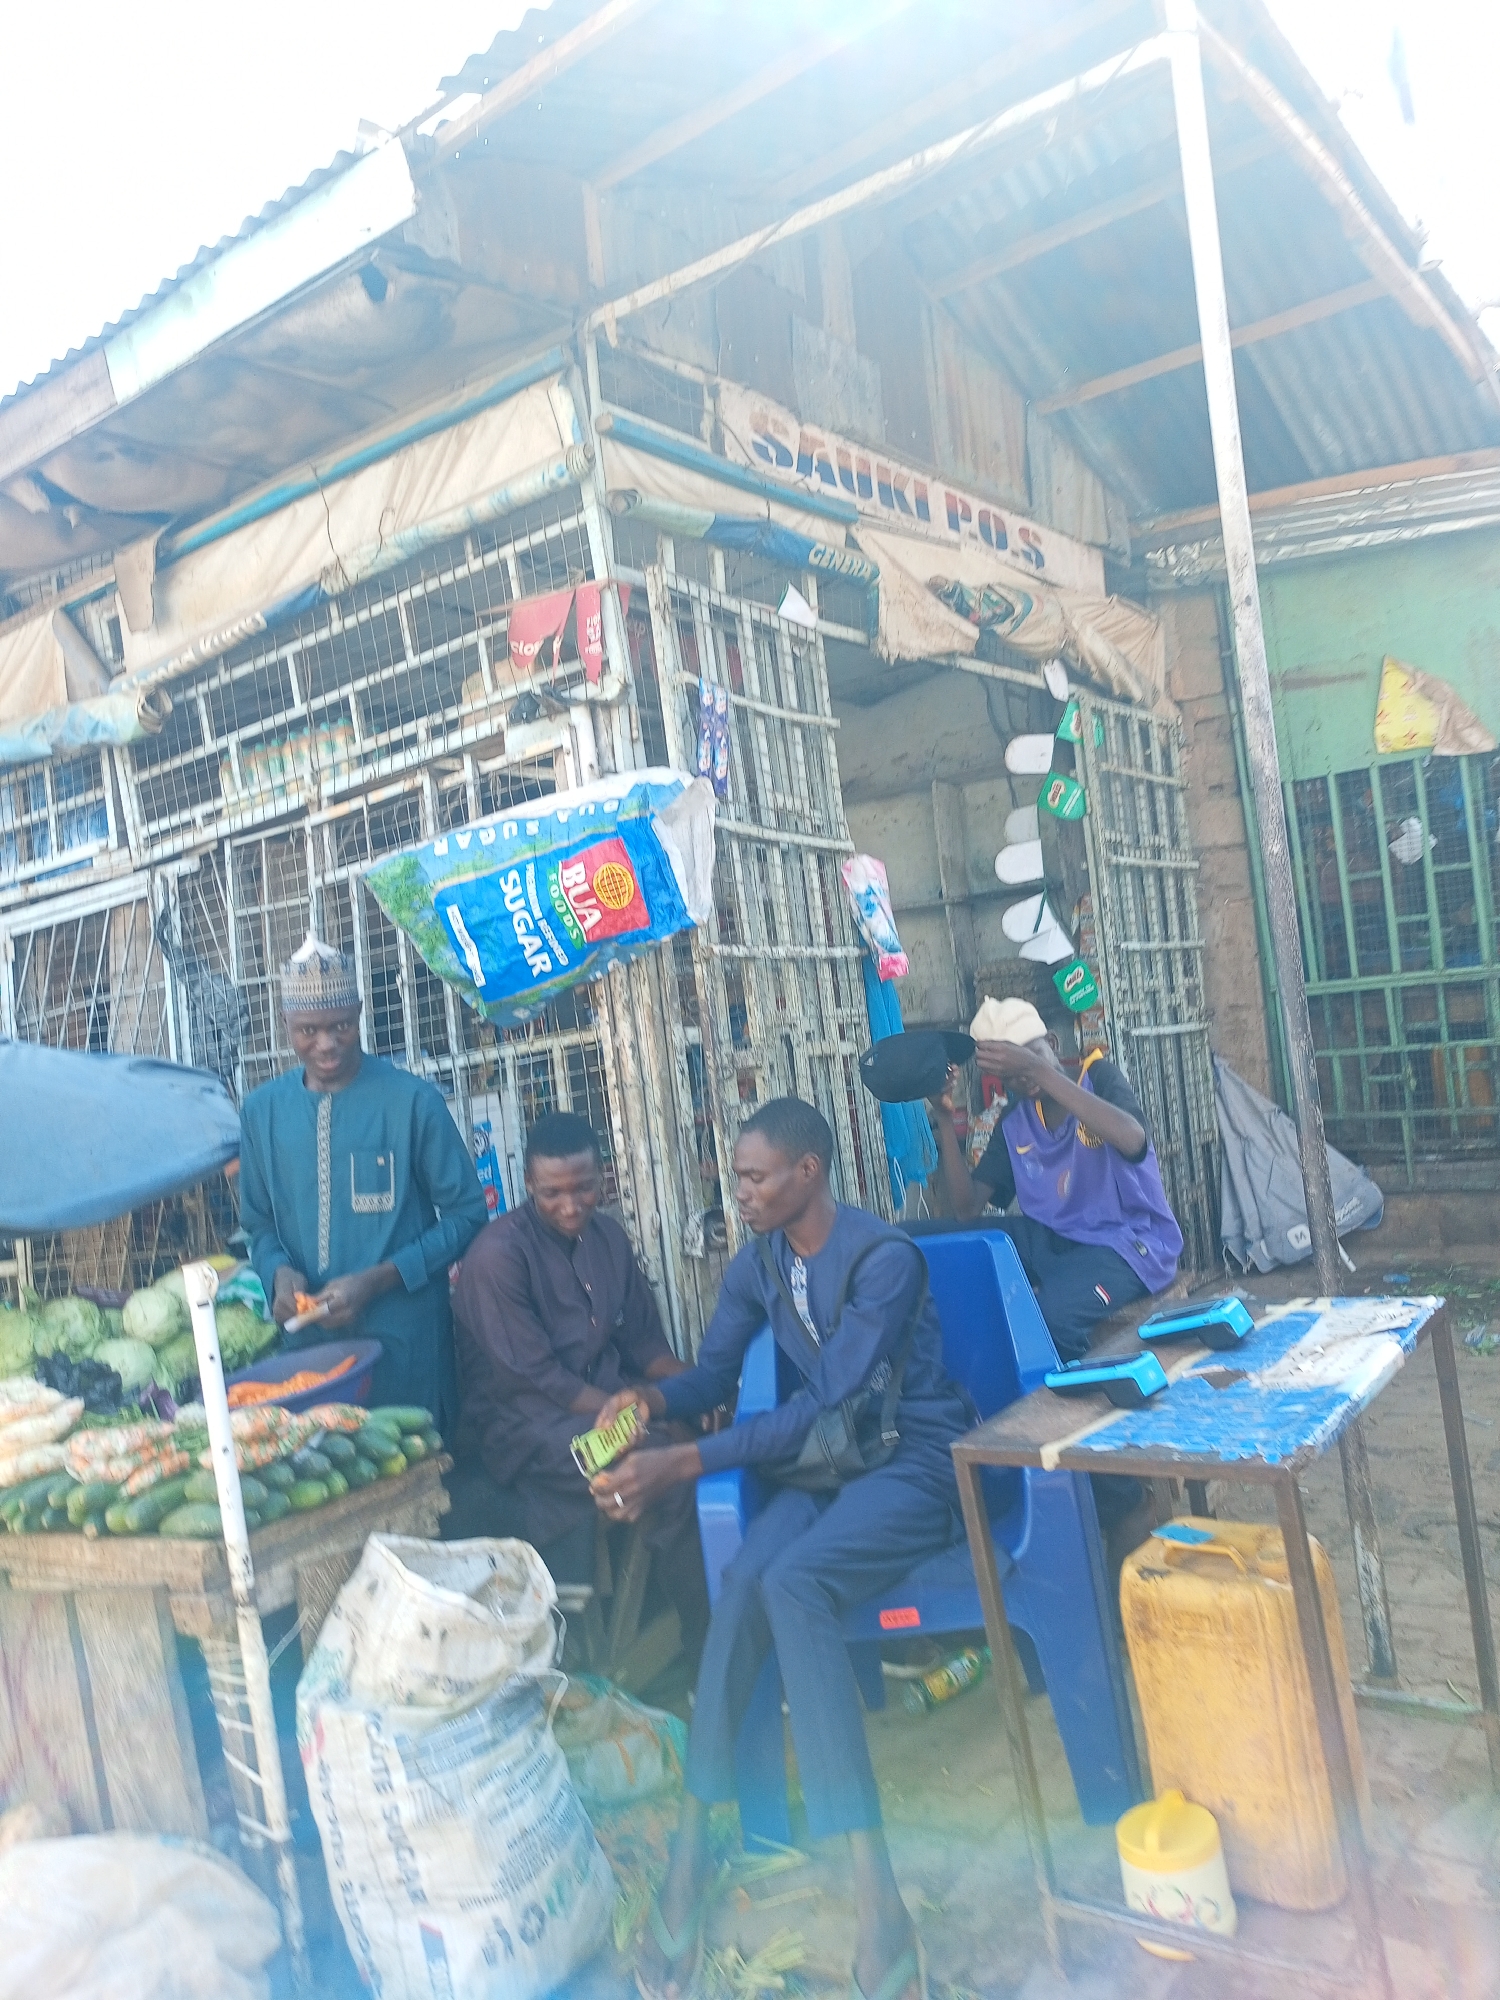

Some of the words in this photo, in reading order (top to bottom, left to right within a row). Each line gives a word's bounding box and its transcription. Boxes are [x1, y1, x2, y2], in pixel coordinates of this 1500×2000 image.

[749, 411, 931, 523] SAUKI
[944, 490, 1045, 570] POS
[434, 819, 540, 857] SUGAR
[499, 868, 553, 979] SUGAR
[548, 872, 581, 940] FOODS
[562, 861, 603, 932] BUA
